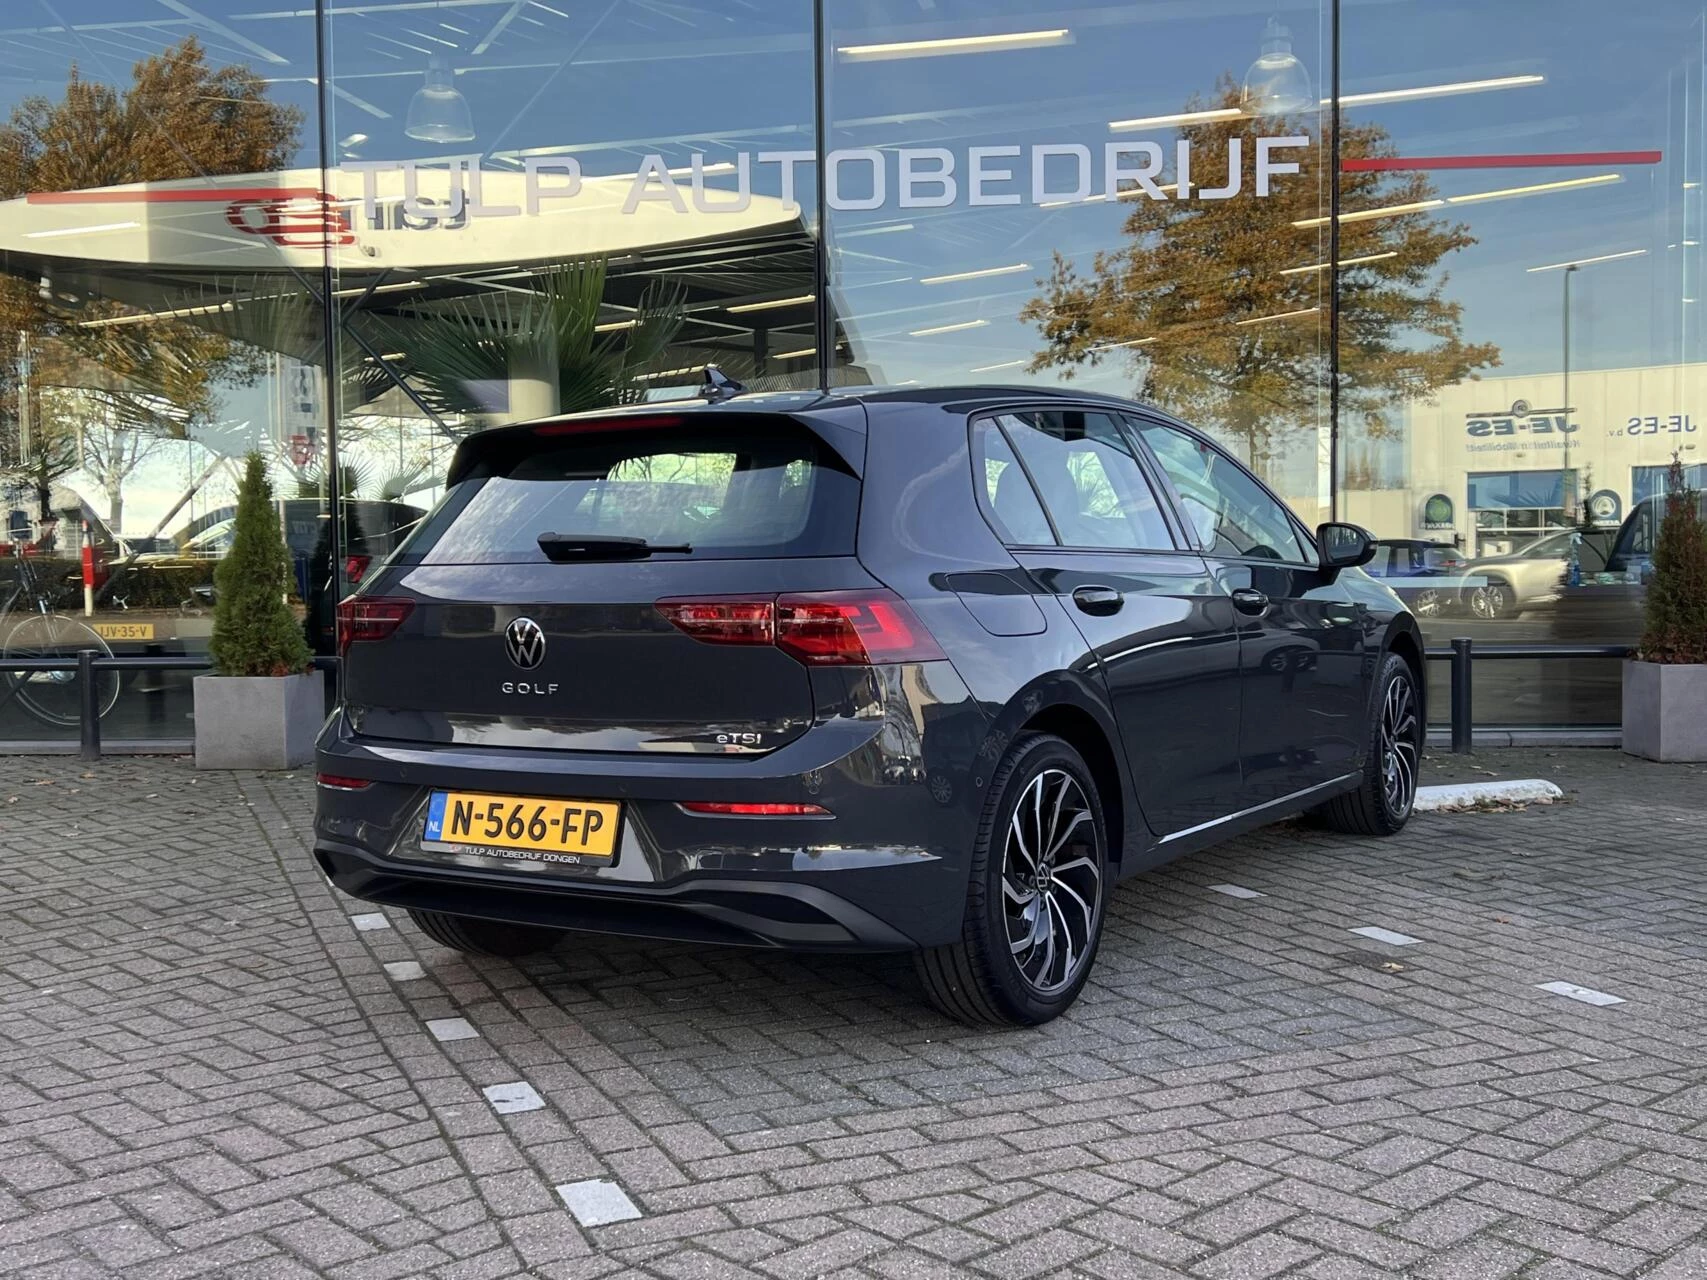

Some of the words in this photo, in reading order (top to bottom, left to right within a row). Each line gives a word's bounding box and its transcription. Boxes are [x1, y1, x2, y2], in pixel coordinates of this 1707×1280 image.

[341, 153, 582, 218] TULP
[621, 135, 1310, 214] AUTOBEDRIJF
[502, 682, 559, 695] GOLF
[716, 732, 762, 745] eTSI
[428, 820, 441, 833] NL
[451, 800, 604, 846] N-566-FP
[464, 846, 485, 855] TULP
[486, 848, 541, 861] AUTOBEDRIJF
[543, 853, 580, 865] DONGEN
